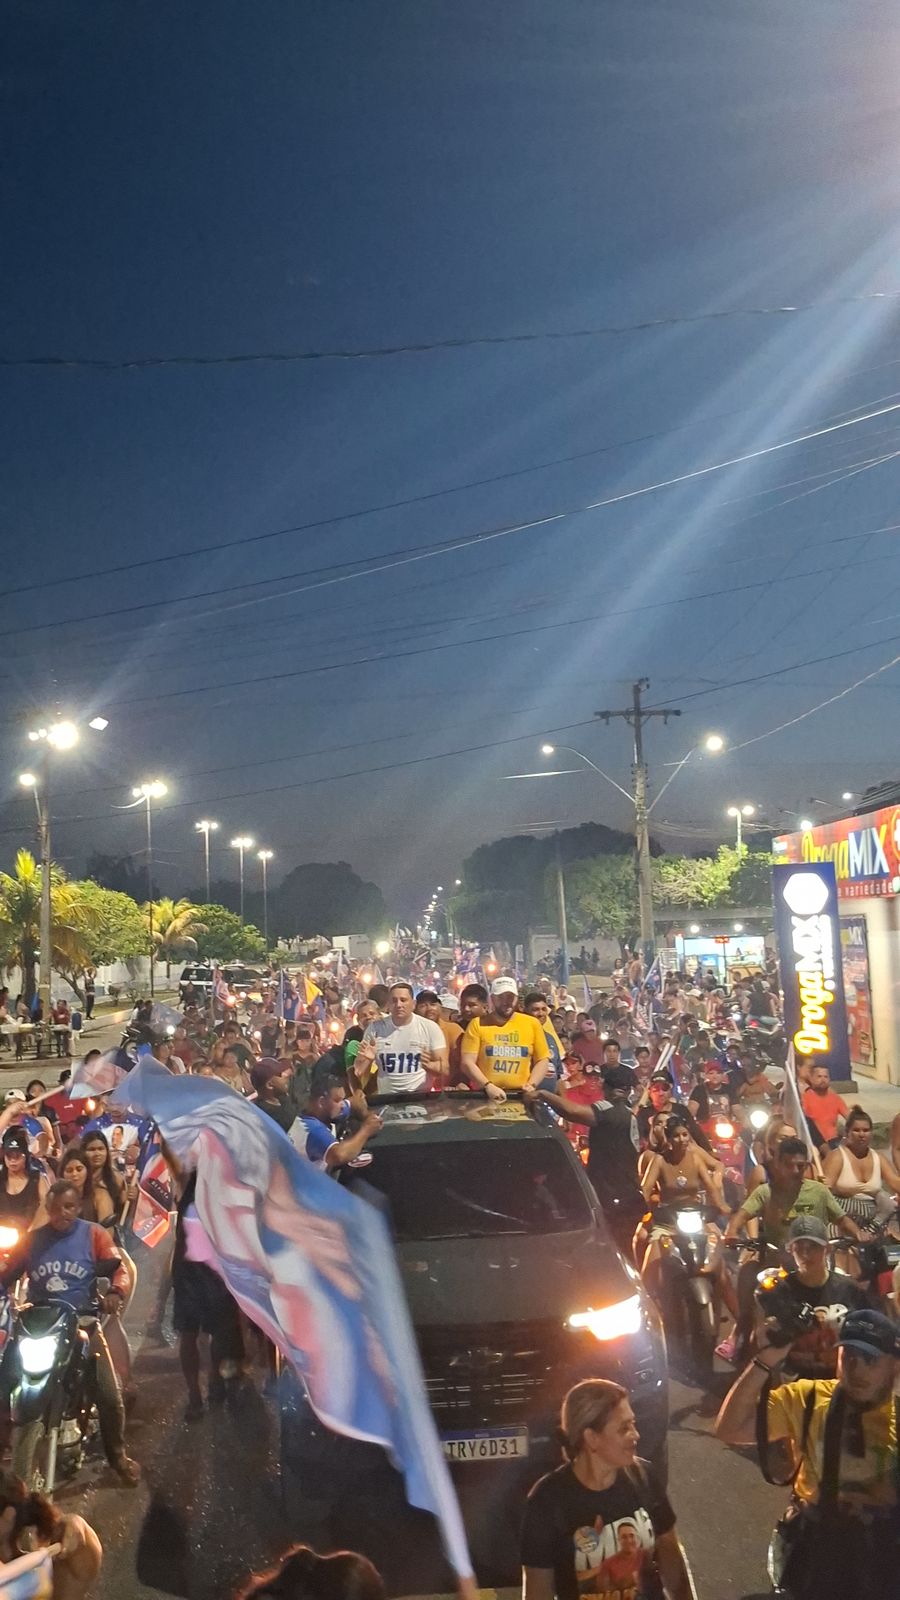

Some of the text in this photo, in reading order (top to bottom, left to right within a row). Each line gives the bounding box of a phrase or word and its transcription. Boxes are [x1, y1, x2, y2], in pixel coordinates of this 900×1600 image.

[791, 914, 834, 1056] DrogaMIX
[493, 1046, 521, 1057] BORBA
[379, 1053, 420, 1073] 15111
[493, 1060, 520, 1074] 4477
[447, 1439, 520, 1458] TRY6D31
